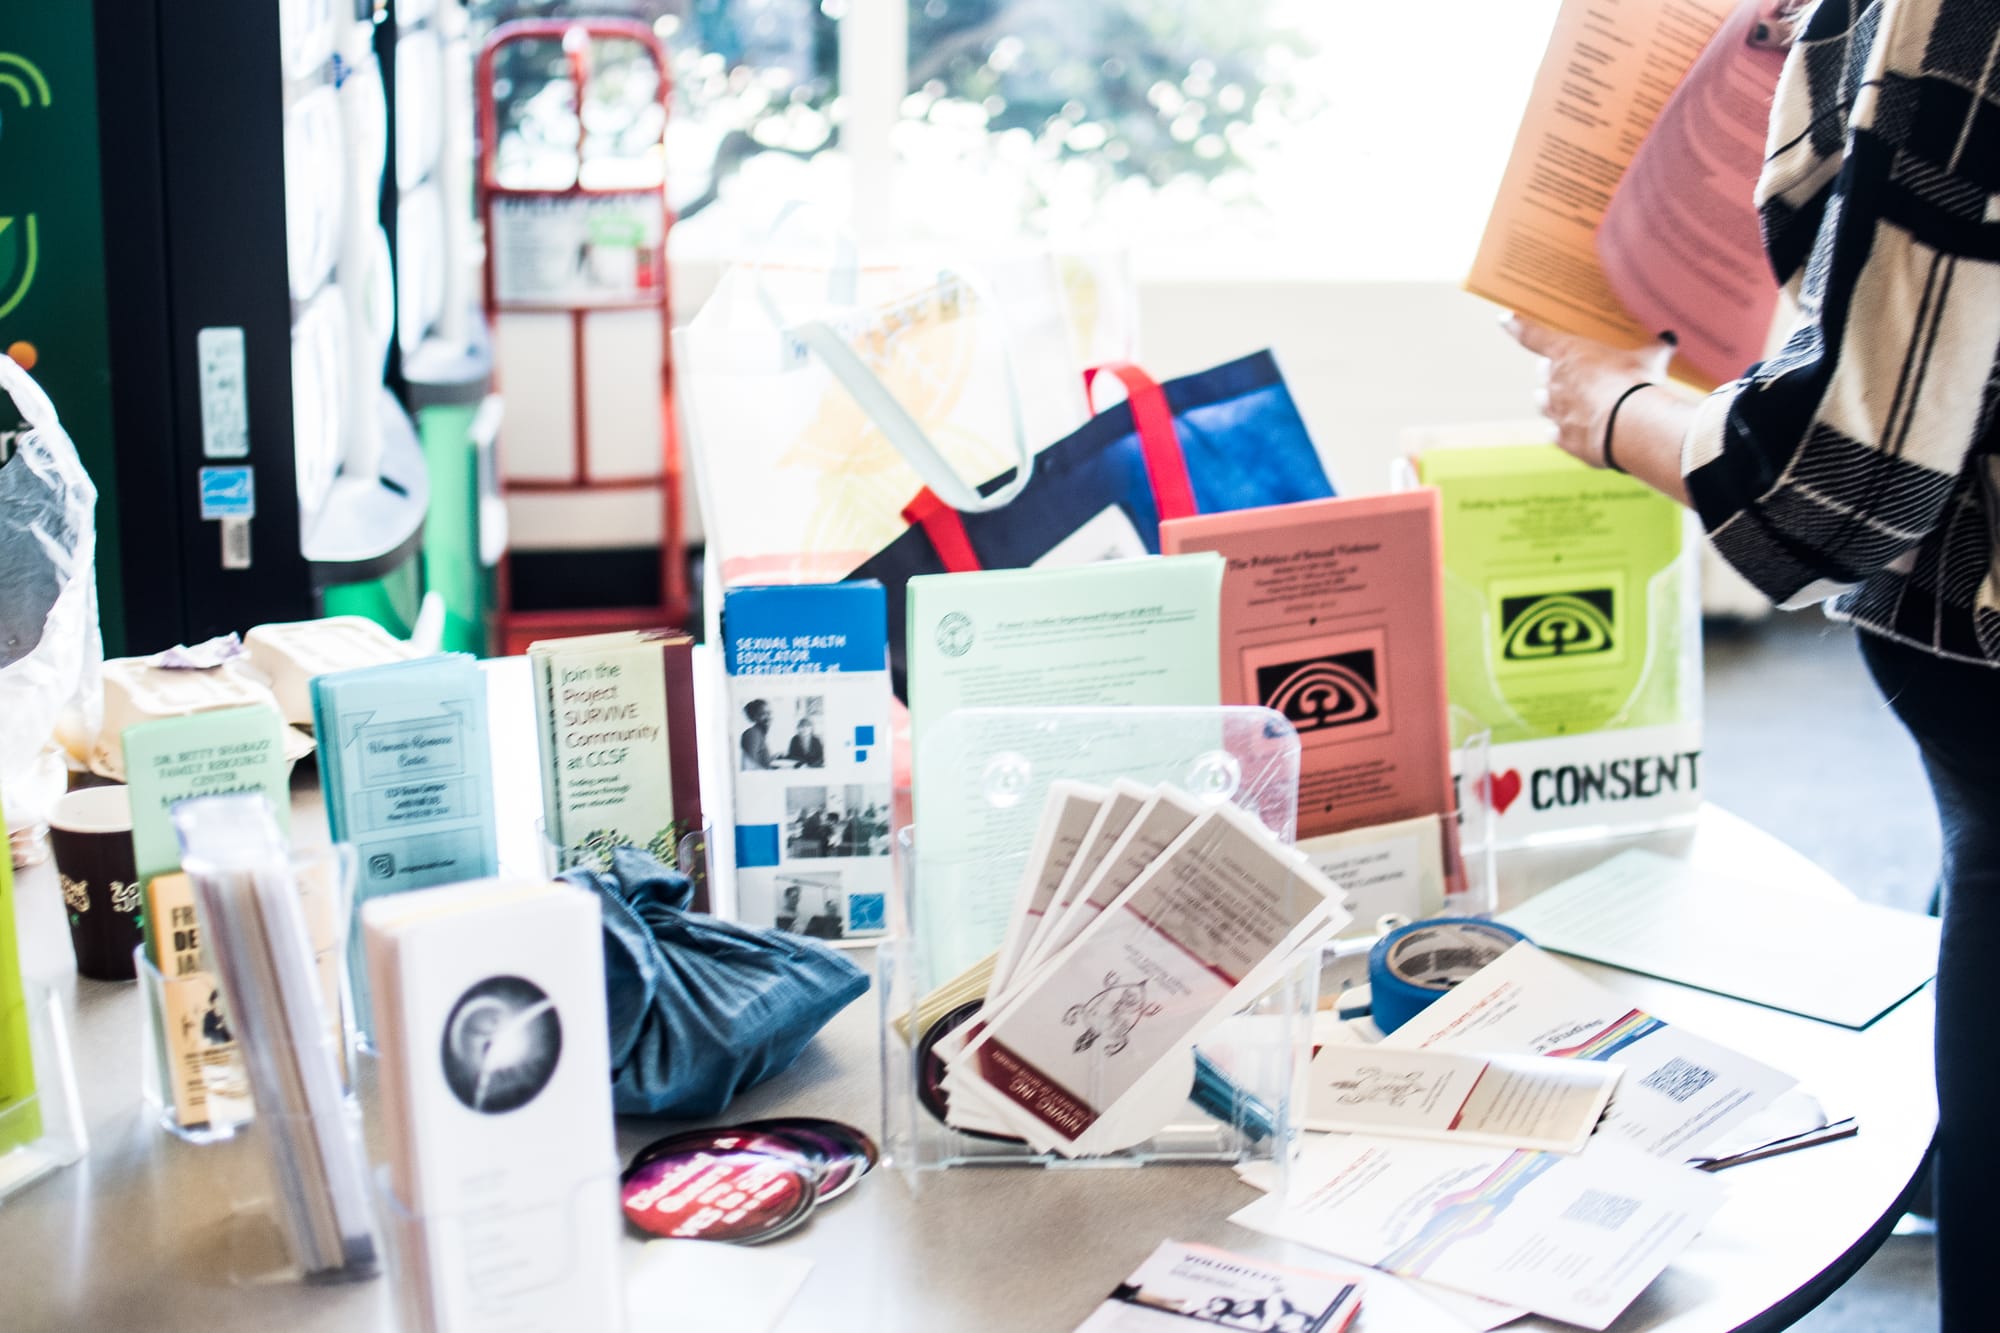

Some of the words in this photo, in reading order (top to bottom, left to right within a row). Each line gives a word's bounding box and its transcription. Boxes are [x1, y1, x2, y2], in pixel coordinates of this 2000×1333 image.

[735, 636, 788, 652] SEXUAL
[792, 634, 847, 649] HEALTH
[736, 650, 811, 665] EDUCATOR
[561, 667, 592, 685] Join
[594, 662, 621, 679] the
[562, 685, 618, 706] Project
[564, 701, 641, 728] SURVIVE
[565, 722, 661, 750] Community
[566, 756, 583, 770] at
[585, 746, 631, 768] CCSF
[191, 771, 238, 788] CENTER
[1530, 750, 1702, 811] CONSENT
[170, 906, 196, 928] FR
[173, 928, 199, 950] DE
